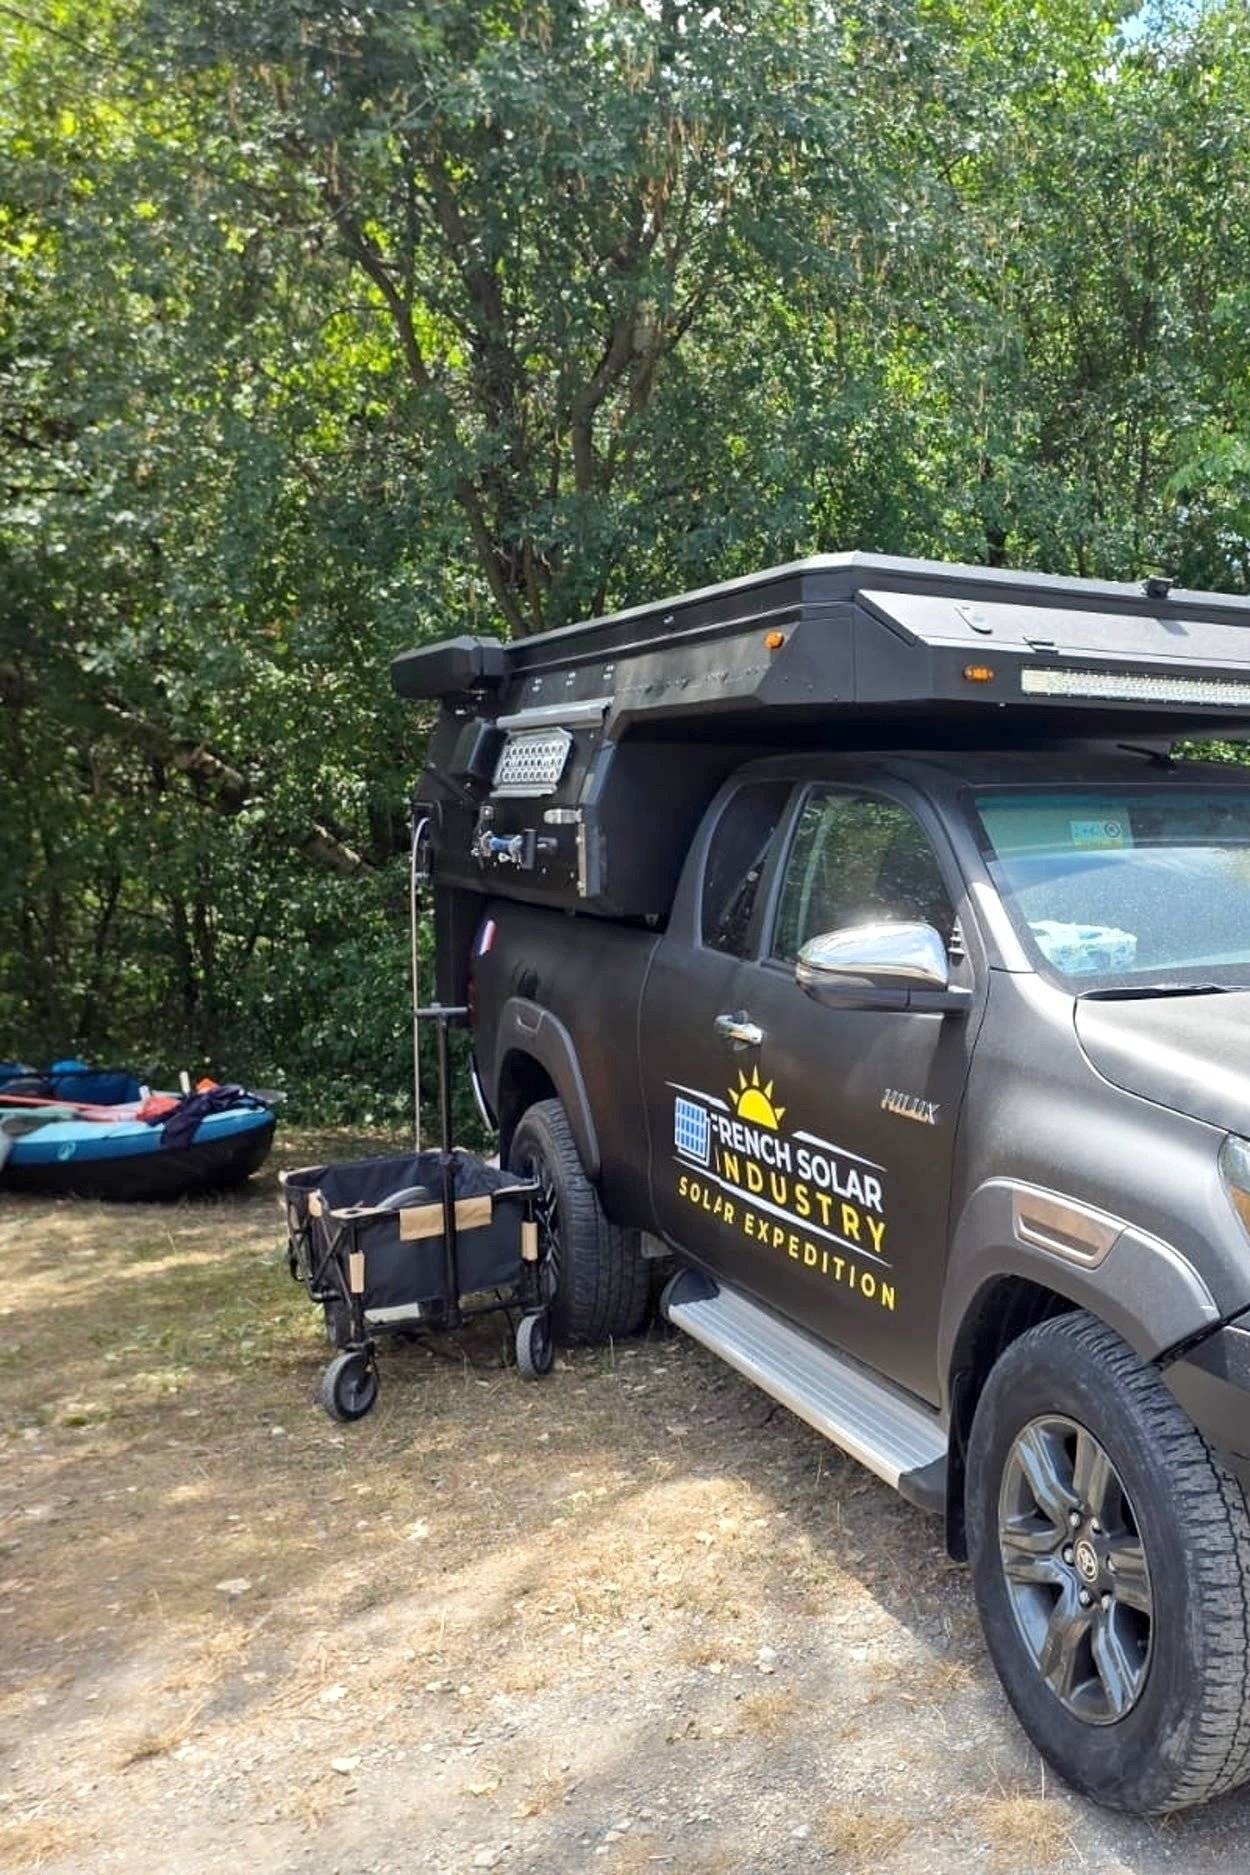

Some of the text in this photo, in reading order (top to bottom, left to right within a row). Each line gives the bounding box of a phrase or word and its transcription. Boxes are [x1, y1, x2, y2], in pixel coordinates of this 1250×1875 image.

[797, 1149, 883, 1213] SOLAR
[679, 1176, 895, 1311] SOLAR EXPEDITION
